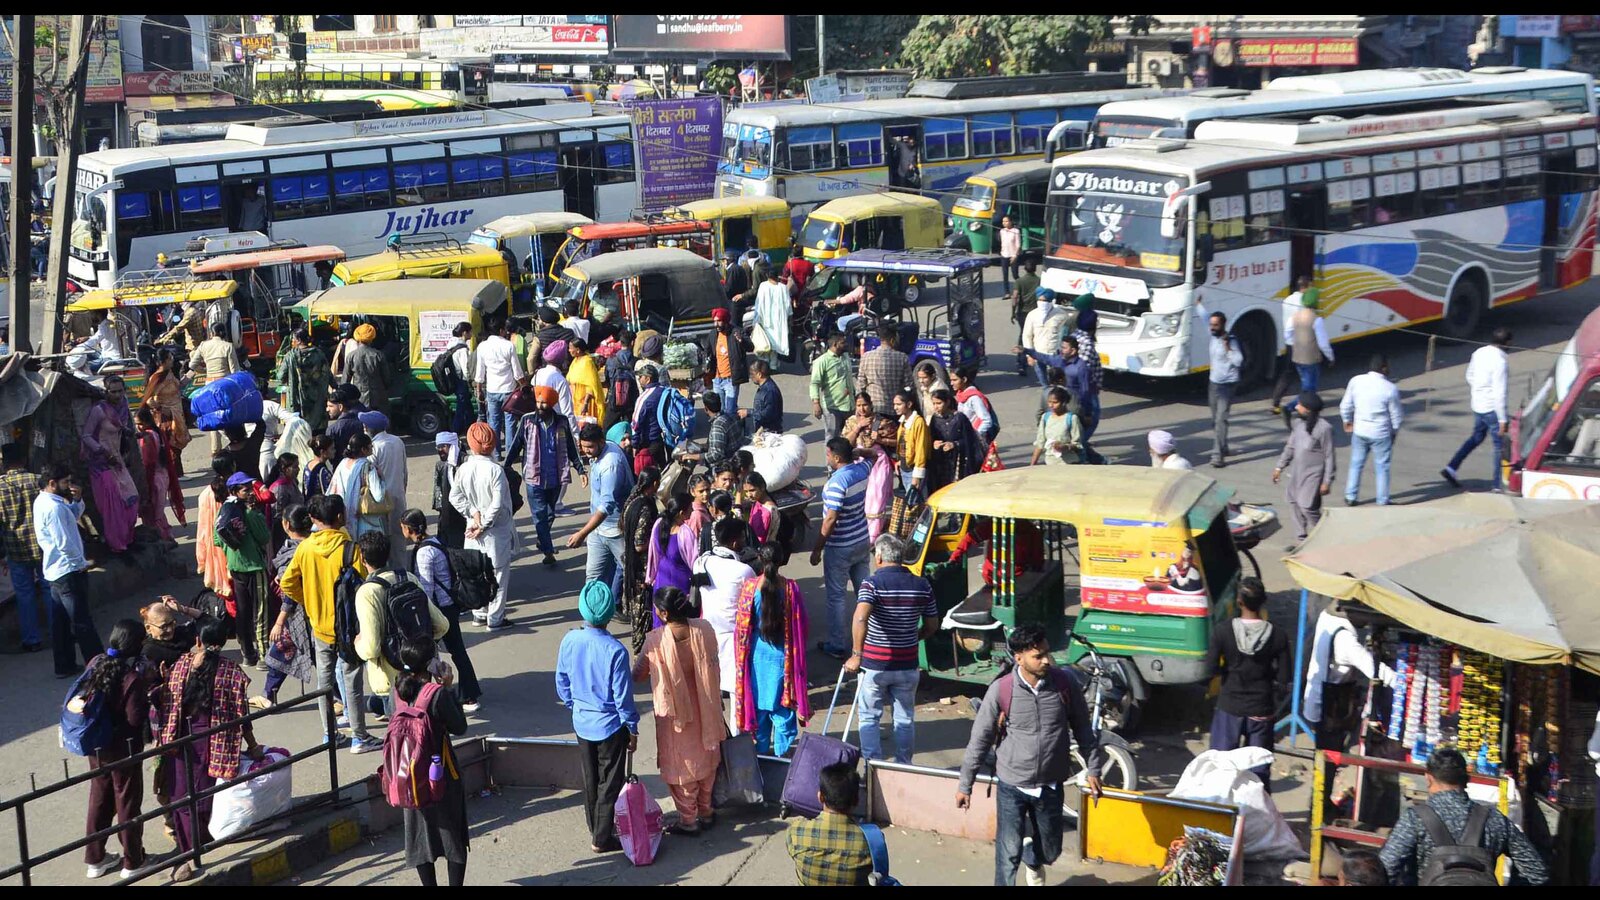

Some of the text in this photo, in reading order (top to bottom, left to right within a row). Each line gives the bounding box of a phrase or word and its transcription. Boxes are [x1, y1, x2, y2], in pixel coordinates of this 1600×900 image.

[670, 23, 743, 34] sandhu@leafberry.in
[183, 72, 211, 83] PARKASH
[76, 169, 105, 190] HAR
[374, 207, 474, 239] Jujhar
